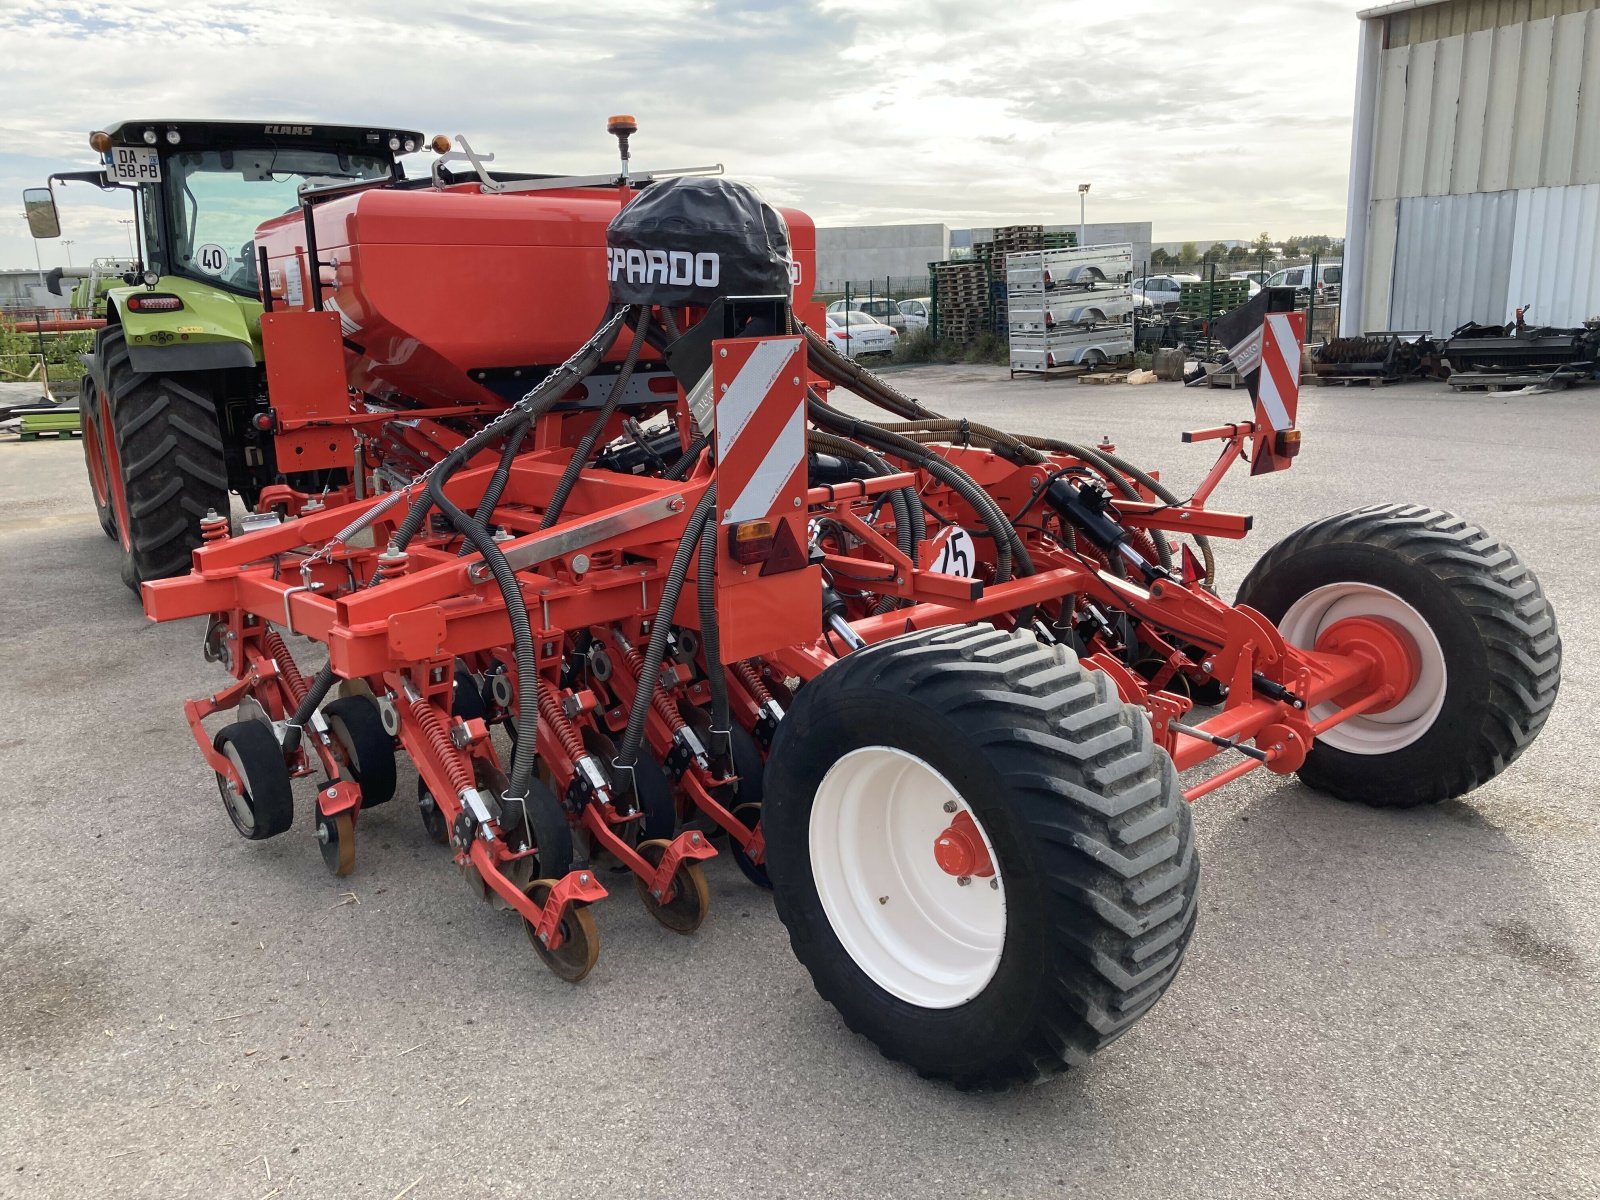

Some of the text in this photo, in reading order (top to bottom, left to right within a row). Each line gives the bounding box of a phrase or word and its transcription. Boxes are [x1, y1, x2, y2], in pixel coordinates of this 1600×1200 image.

[264, 125, 313, 136] CLAAS
[111, 164, 158, 178] 158-PB
[203, 249, 222, 270] 40
